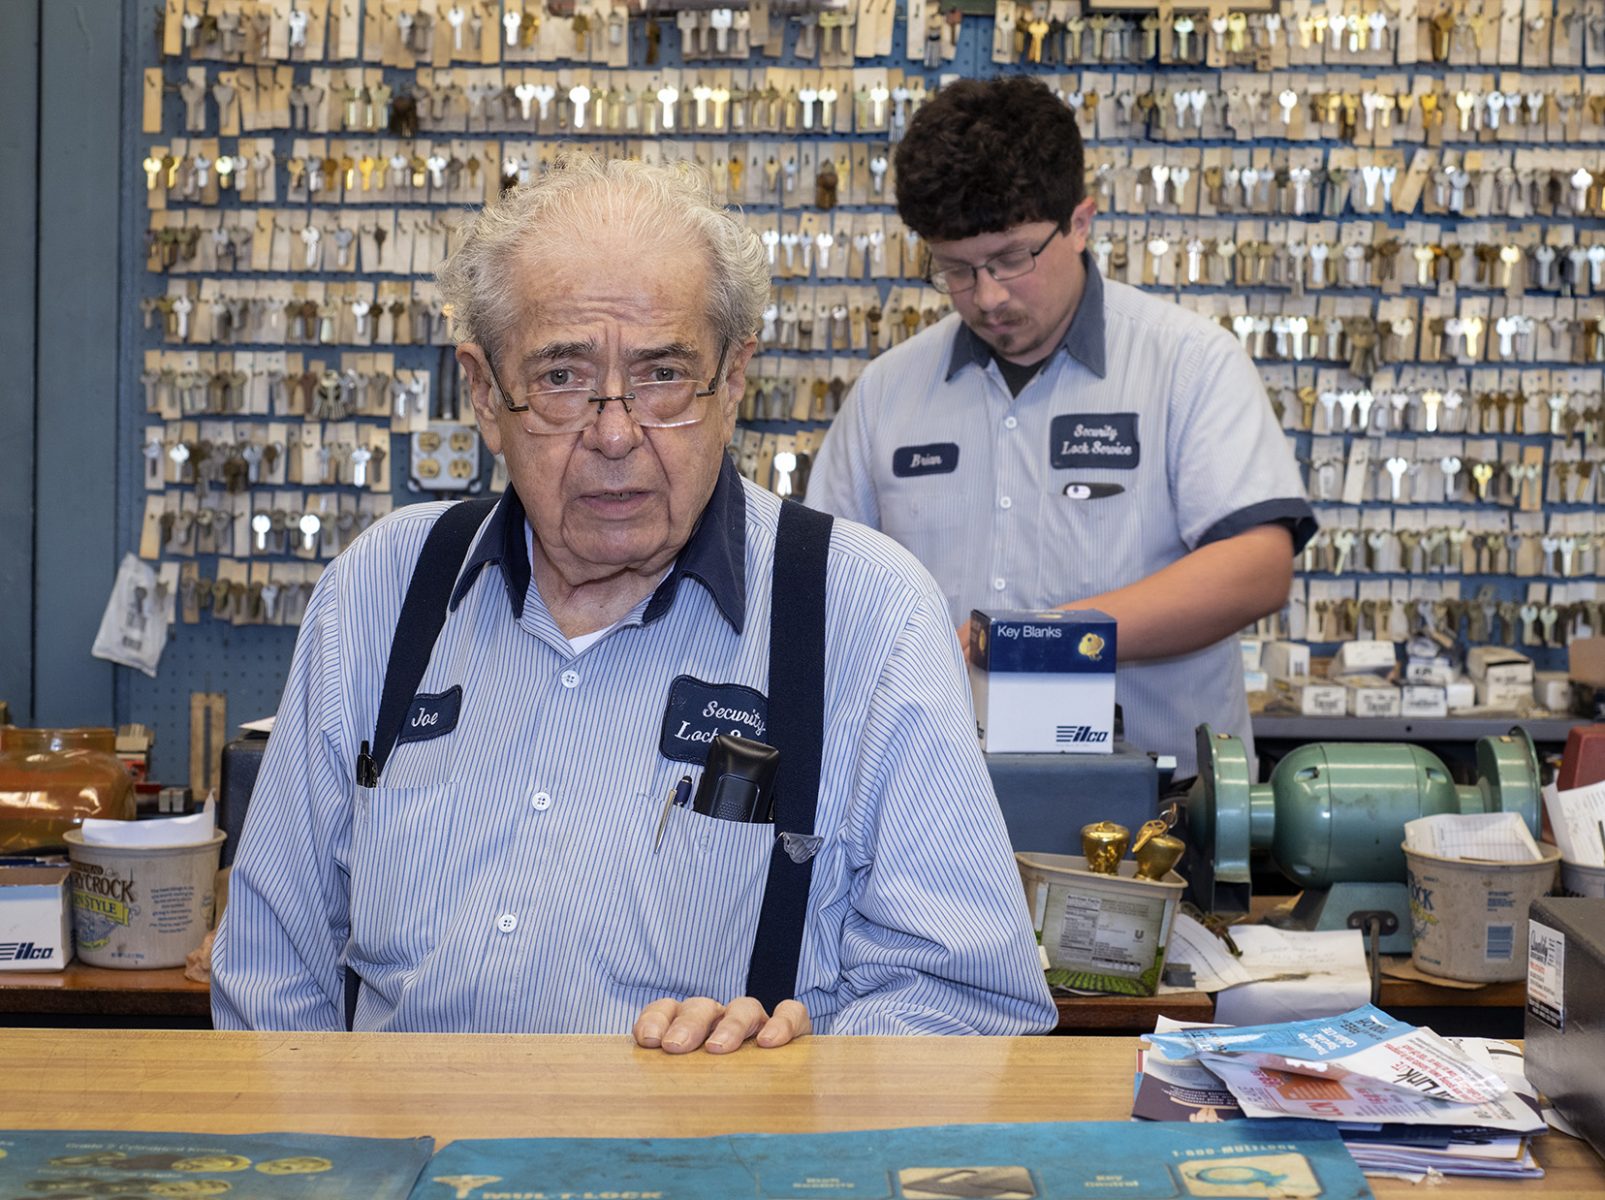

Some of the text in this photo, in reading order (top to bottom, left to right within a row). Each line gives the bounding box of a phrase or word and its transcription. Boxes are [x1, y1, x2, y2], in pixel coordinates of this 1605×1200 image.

[1074, 424, 1118, 441] Security
[1061, 441, 1132, 455] Lock Service
[910, 453, 942, 468] Brian
[997, 625, 1062, 640] Key Blanks
[411, 707, 439, 727] Joe
[702, 700, 766, 736] Security
[1072, 726, 1109, 742] ilco
[14, 942, 54, 960] ilco
